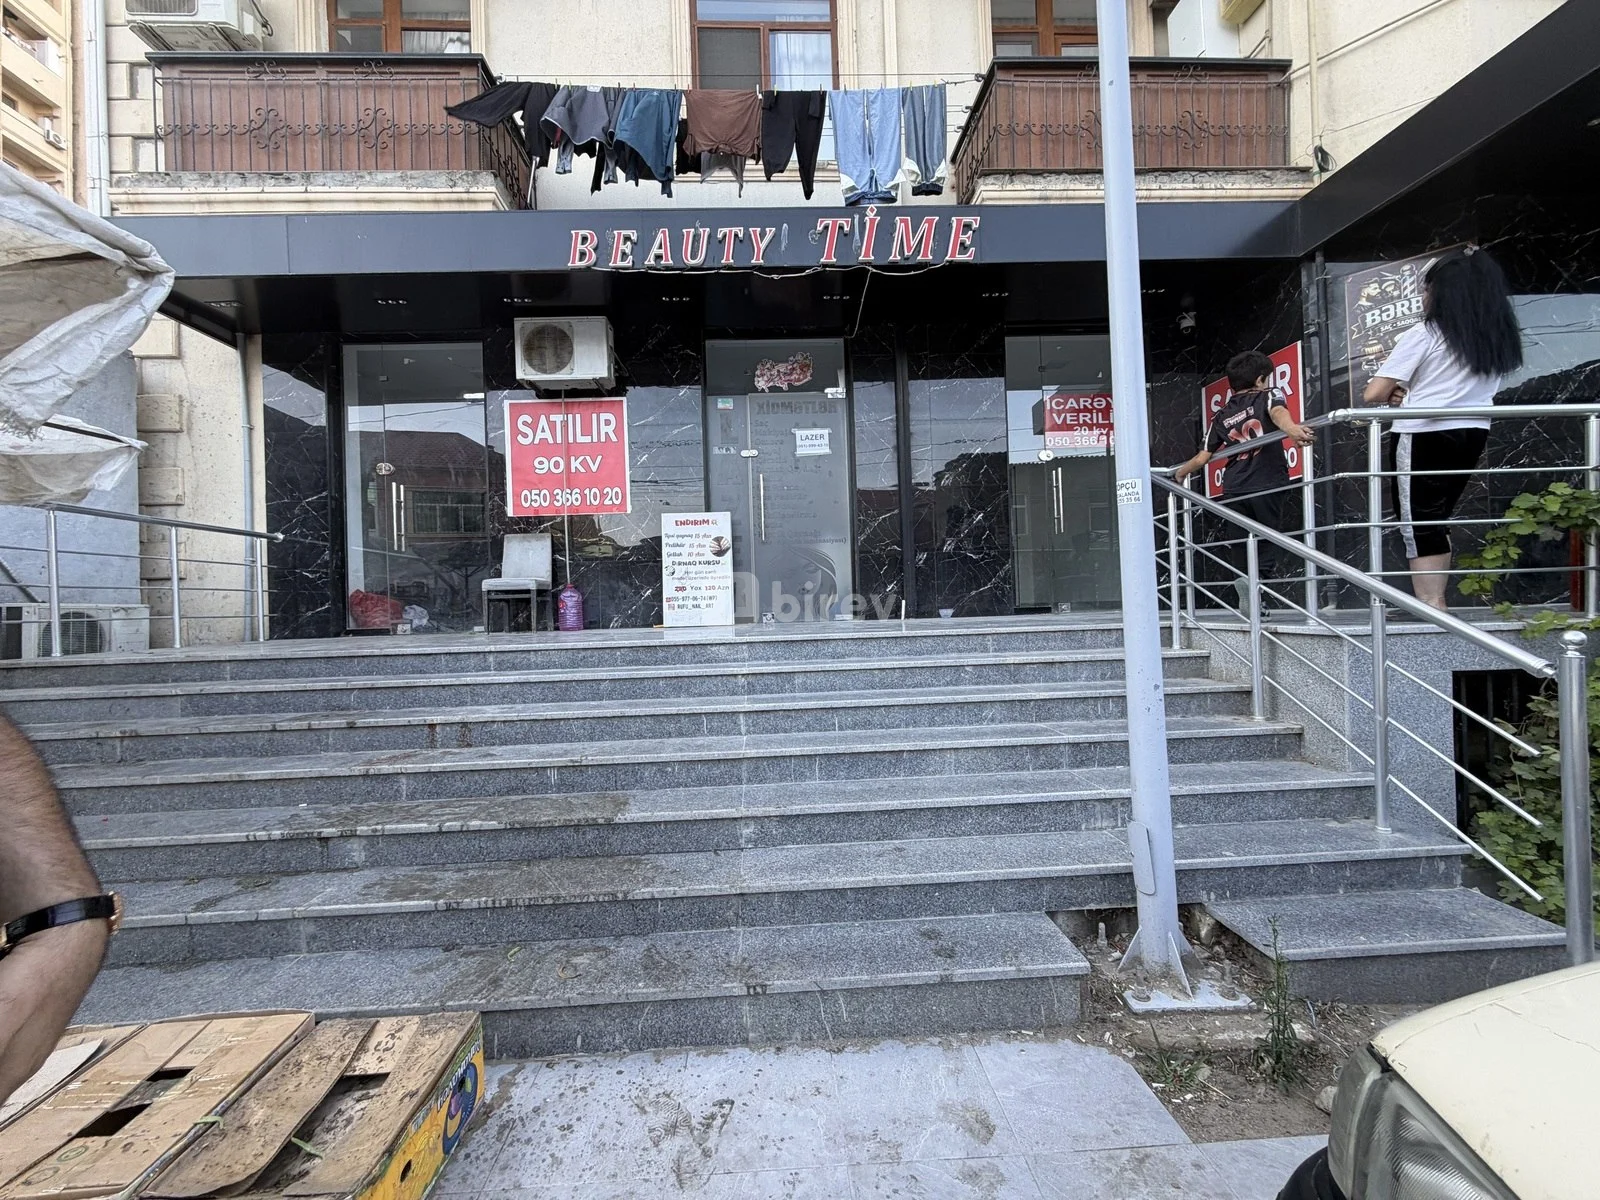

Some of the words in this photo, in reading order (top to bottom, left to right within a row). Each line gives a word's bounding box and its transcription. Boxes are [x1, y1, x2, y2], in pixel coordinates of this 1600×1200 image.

[568, 228, 775, 267] BEAUTY
[816, 205, 980, 264] TİME
[516, 412, 618, 445] SATILIR
[1073, 426, 1089, 436] 20
[1046, 436, 1070, 447] 050
[1074, 436, 1098, 446] 366
[533, 456, 564, 474] 90
[570, 455, 603, 473] KV
[520, 489, 551, 508] 050
[553, 488, 582, 507] 366
[584, 487, 600, 506] 10
[603, 486, 623, 506] 20
